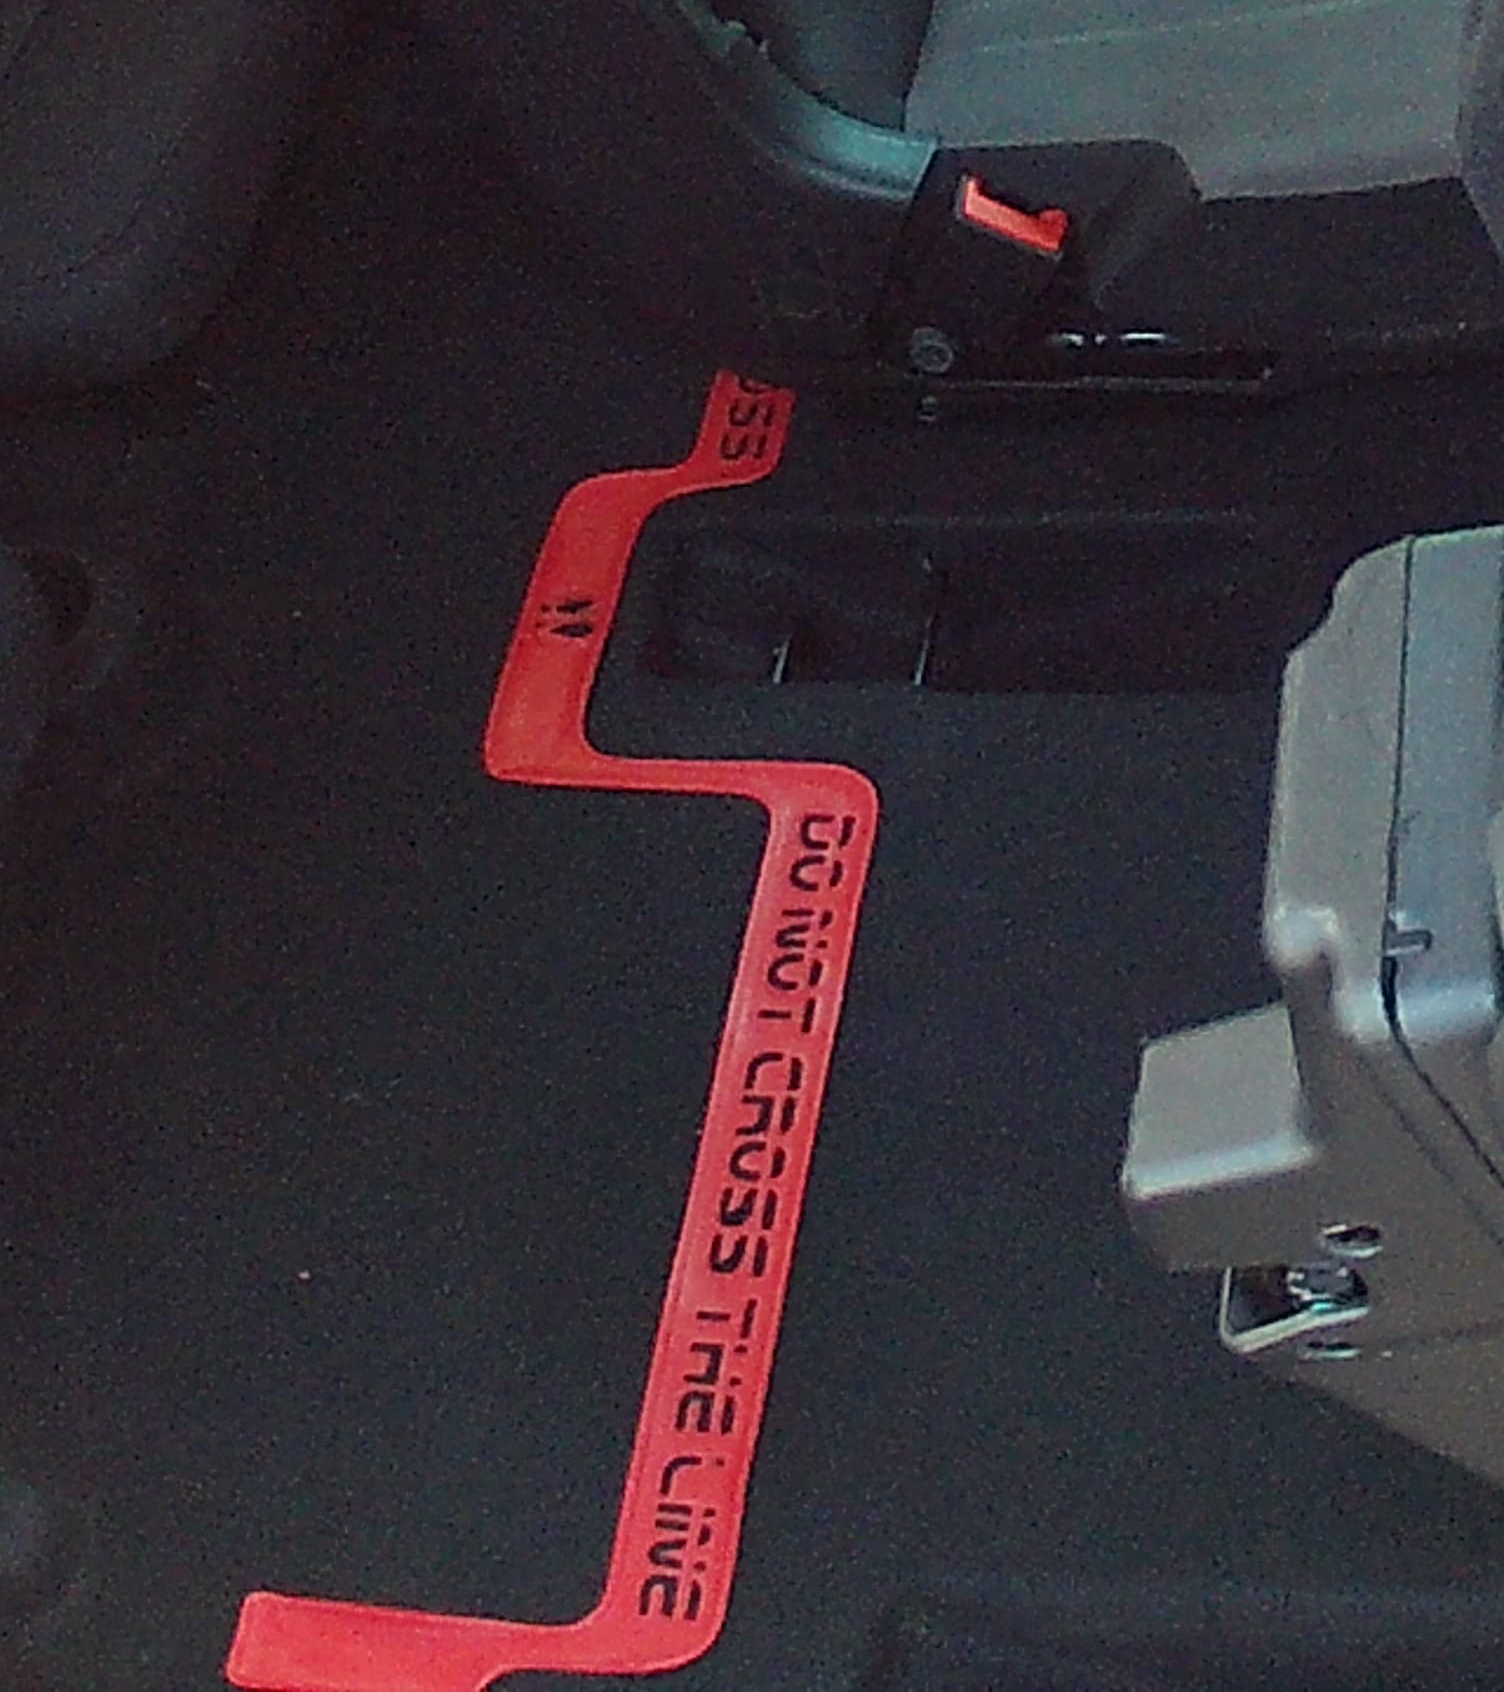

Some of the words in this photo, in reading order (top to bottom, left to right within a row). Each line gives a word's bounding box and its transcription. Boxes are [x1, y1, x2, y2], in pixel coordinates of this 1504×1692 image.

[789, 813, 856, 892] DO
[757, 909, 833, 1034] NOT
[709, 1052, 804, 1278] CROSS
[675, 1299, 757, 1435] THE
[639, 1456, 721, 1620] LINE
